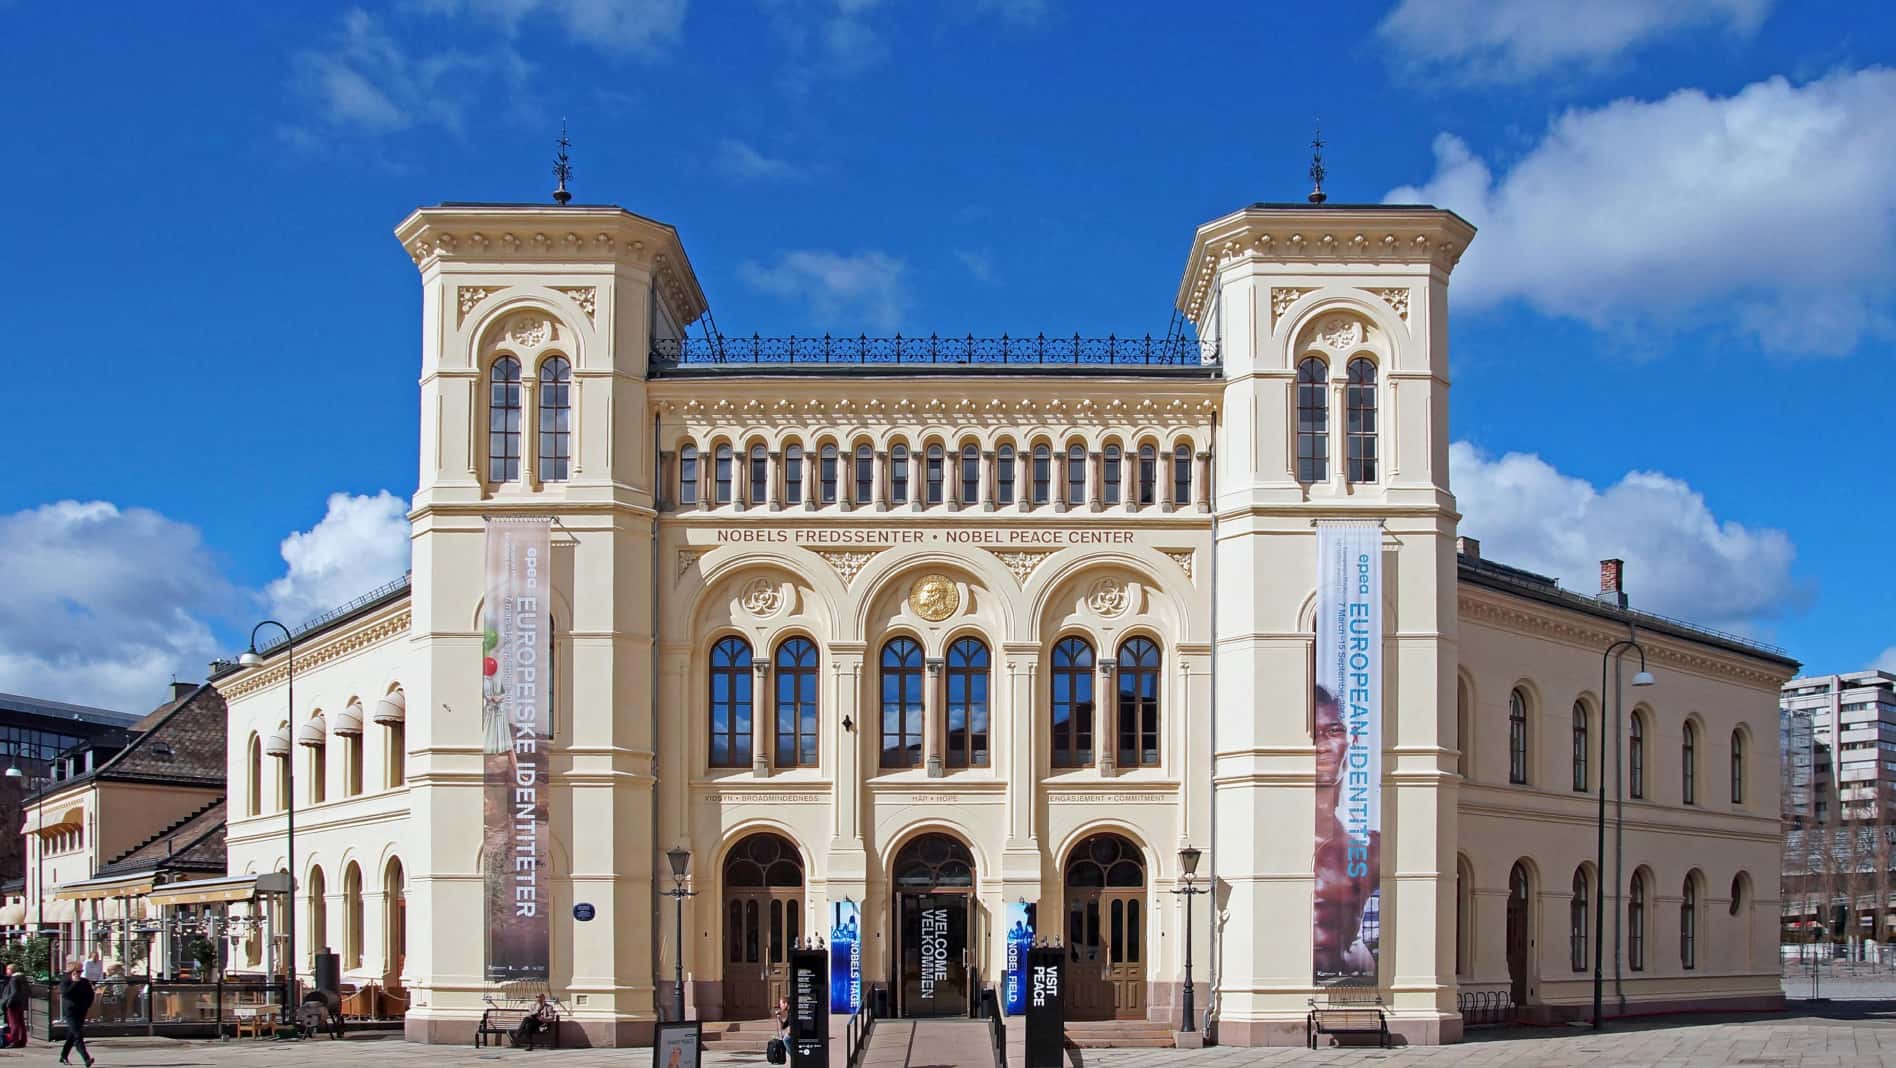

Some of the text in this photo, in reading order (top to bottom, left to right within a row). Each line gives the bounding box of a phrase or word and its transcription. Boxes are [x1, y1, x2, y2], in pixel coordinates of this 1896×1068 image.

[717, 530, 1134, 544] NOBELS FREDSSENTER NOBEL PEACE CENTER
[516, 548, 536, 917] epea EUROPEISKE IDENTITETER
[1348, 554, 1370, 878] epea EUROPEAN IDENTITIES
[1113, 794, 1165, 802] COMMITMENT
[850, 940, 859, 1008] NOBELS HAGE
[922, 910, 934, 999] VELKOMMEN
[934, 910, 947, 981] WELCOME
[1008, 942, 1018, 1002] NOBEL FIELD
[1034, 966, 1045, 1007] PEACE
[1046, 966, 1058, 996] VISIT
